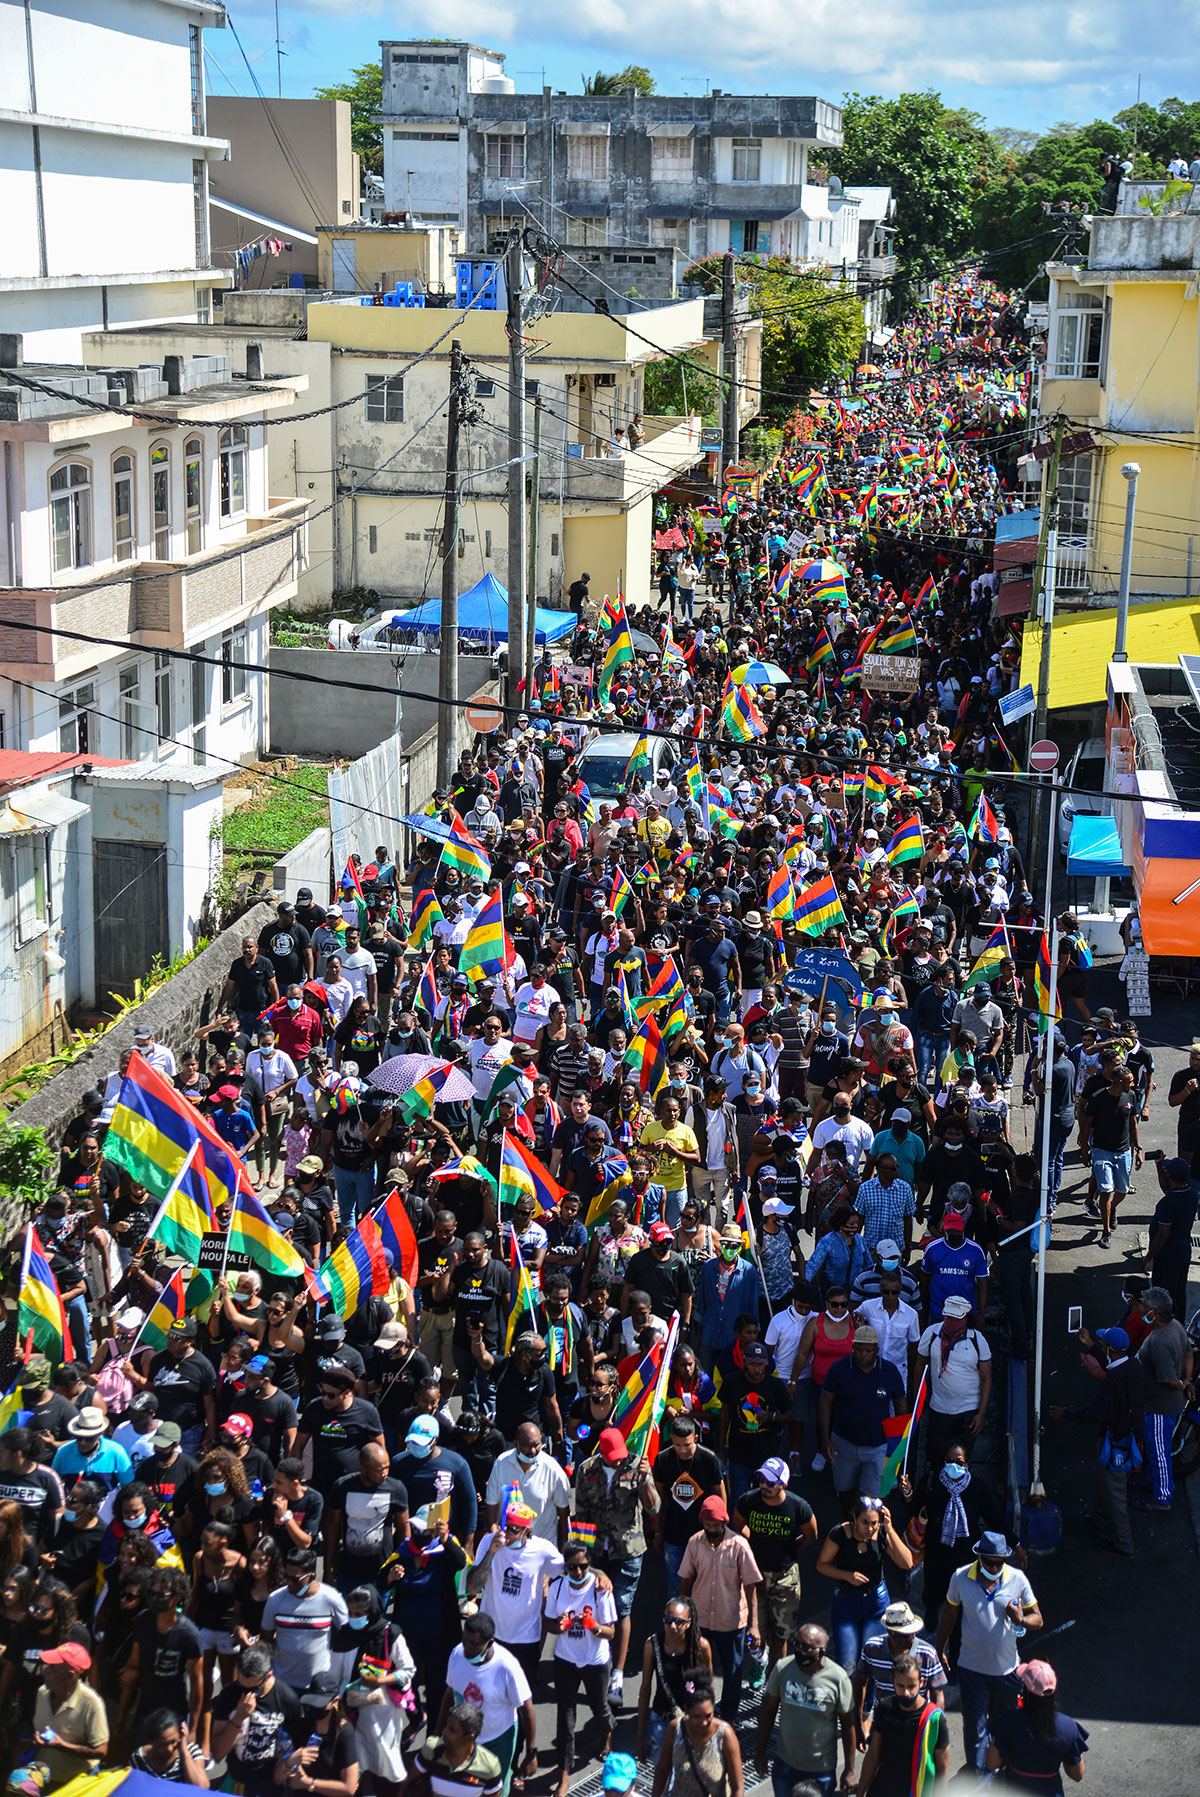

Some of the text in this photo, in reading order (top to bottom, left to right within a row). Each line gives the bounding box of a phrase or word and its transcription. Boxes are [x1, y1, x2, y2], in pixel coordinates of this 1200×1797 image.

[895, 657, 906, 667] TON
[908, 658, 921, 669] SAC
[864, 666, 873, 674] ET
[804, 953, 815, 963] Le
[201, 1252, 223, 1261] NOU
[238, 1255, 249, 1264] LE
[939, 1267, 969, 1275] SAMSUNG
[750, 1510, 791, 1523] Reduce
[749, 1518, 782, 1529] Reuse
